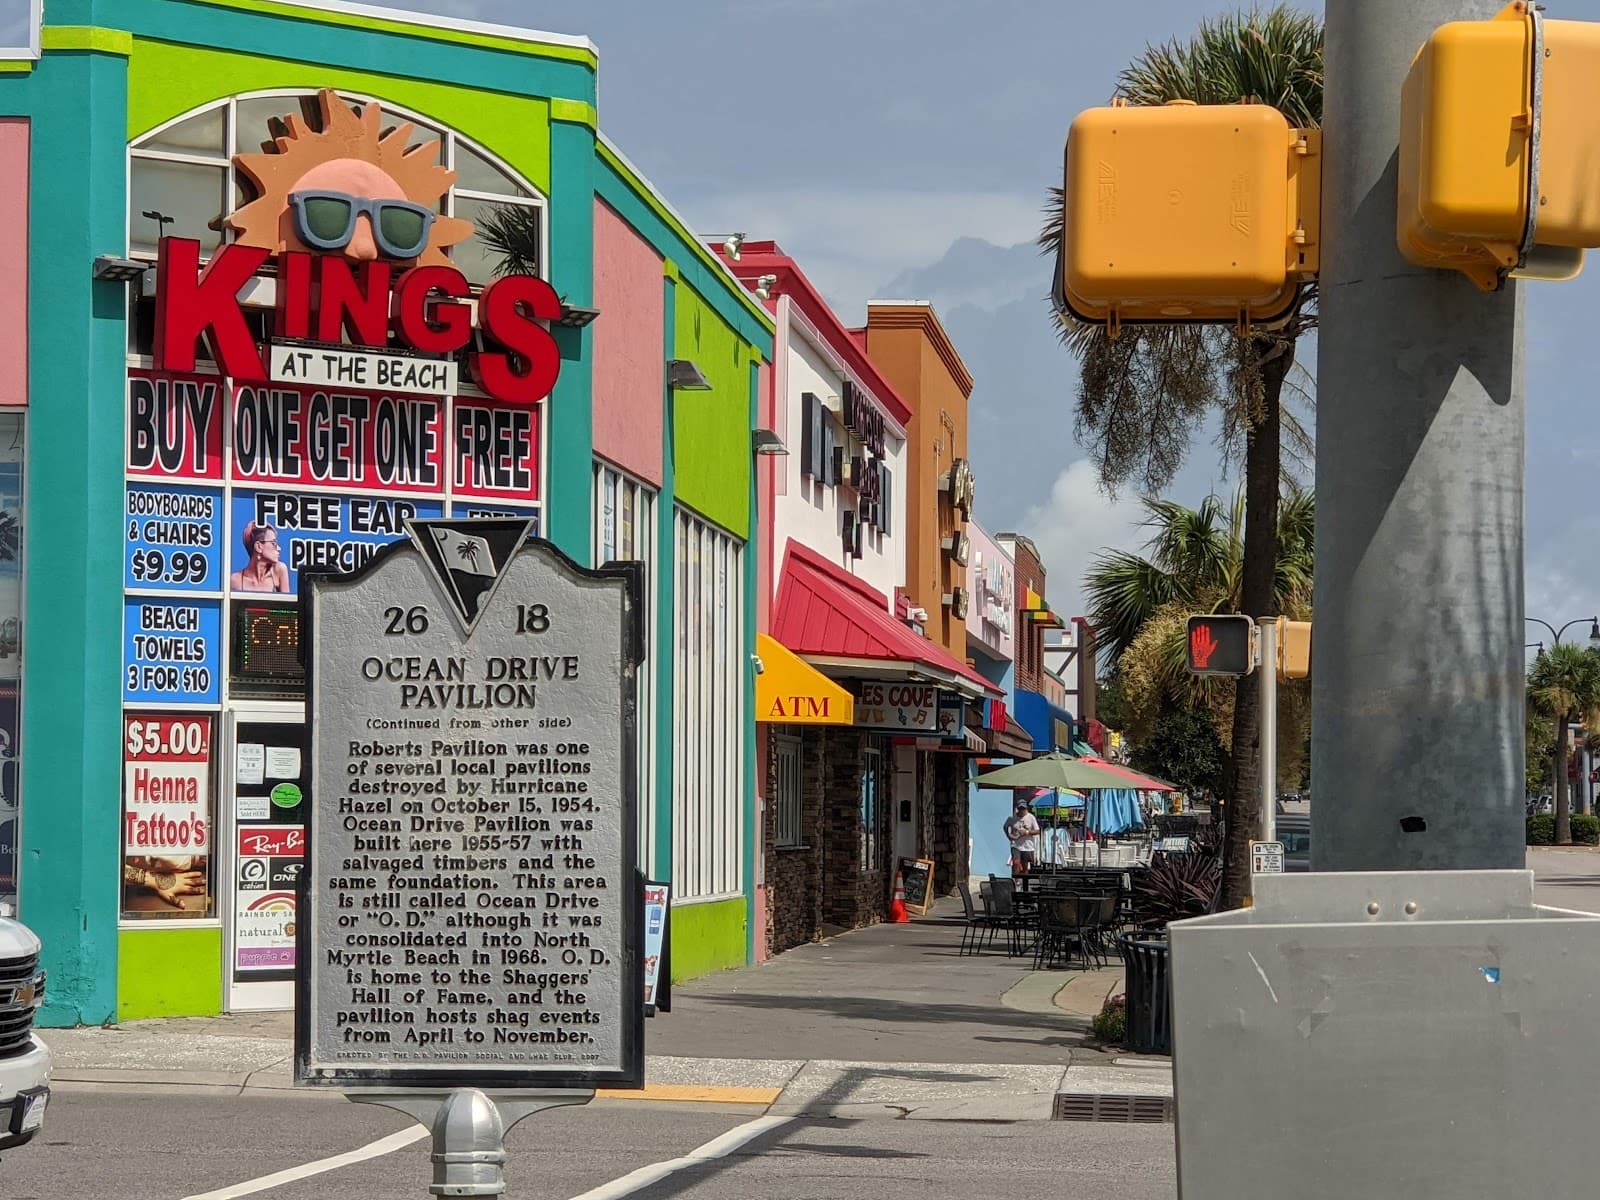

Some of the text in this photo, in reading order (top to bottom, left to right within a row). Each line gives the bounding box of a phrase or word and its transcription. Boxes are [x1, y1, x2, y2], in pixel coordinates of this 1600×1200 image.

[154, 235, 562, 403] KINGS
[281, 352, 447, 390] AT THE BEACH
[130, 377, 531, 491] BUY ONE GET ONE FREE
[128, 492, 212, 519] BODYBOARDS
[256, 494, 415, 535] FREE EAR
[129, 521, 211, 546] & CHAIRS
[291, 539, 388, 572] PIERCIN
[132, 550, 207, 583] $9.99
[142, 605, 198, 630] BEACH
[384, 603, 550, 635] 26 18
[134, 636, 205, 661] TOWELS
[128, 666, 209, 692] 3 FOR $10
[362, 656, 579, 681] OCEAN DRIVE
[400, 684, 536, 709] PAVILION
[769, 696, 830, 717] ATM
[857, 686, 884, 706] ES
[888, 686, 934, 708] COVE
[366, 716, 572, 729] (Continued from other side)
[127, 720, 202, 758] $5.00
[349, 740, 590, 756] Roberts Pavilion was one
[347, 759, 591, 778] of several local pavilions
[133, 767, 199, 803] Henna
[349, 778, 588, 796] destroyed by Hurricane
[339, 797, 600, 814] Hazel on October 15, 1954.
[126, 811, 206, 847] Tattoo's
[343, 815, 593, 832] Ocean Drive Pavilion was
[354, 835, 582, 852] built here 1955-57 with
[343, 854, 595, 873] salvaged timbers and the
[329, 873, 607, 889] same foundation. This area
[339, 892, 599, 908] is still called Ocean Drive
[239, 923, 283, 938] natural
[338, 916, 358, 927] or
[446, 911, 531, 931] although
[542, 912, 558, 927] it
[568, 916, 601, 927] was
[346, 931, 590, 947] consolidated into North
[327, 949, 392, 967] Myrtle
[405, 949, 460, 965] Beach
[472, 949, 490, 965] in
[501, 949, 547, 965] 1968.
[346, 968, 592, 988] is home to the Shaggers'
[352, 987, 586, 1005] Hall of Fame, and the
[336, 1007, 600, 1027] pavilion hosts shag events
[344, 1027, 594, 1046] from April to November.
